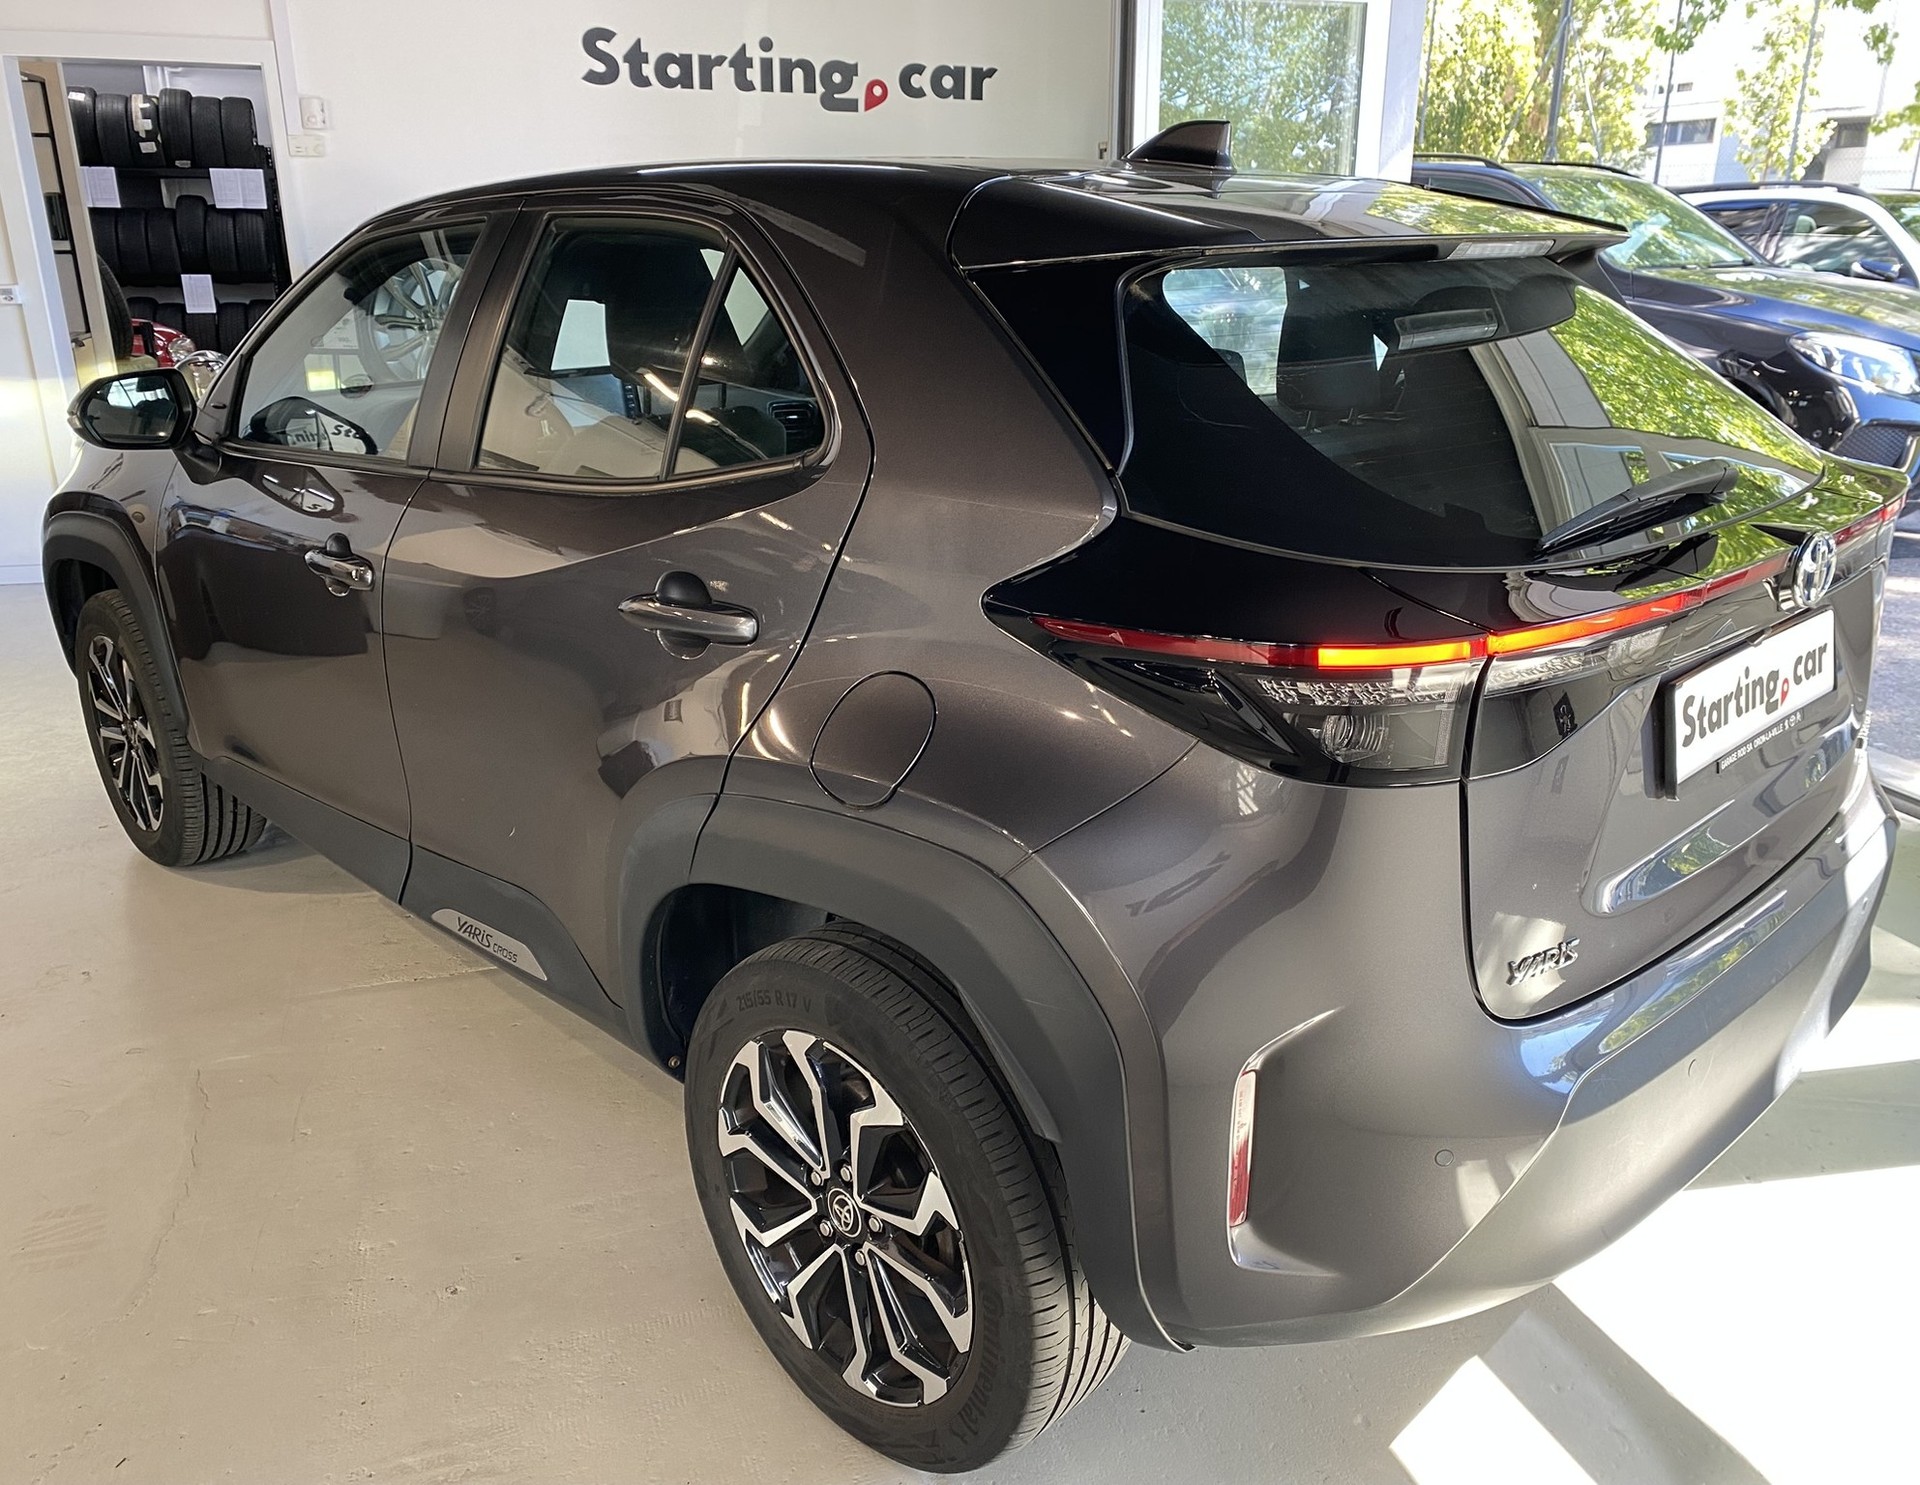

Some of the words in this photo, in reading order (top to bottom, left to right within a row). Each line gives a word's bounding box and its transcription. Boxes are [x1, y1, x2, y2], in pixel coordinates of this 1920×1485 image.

[581, 26, 859, 113] Starting
[899, 62, 998, 101] car
[1682, 666, 1780, 748] Starting
[1793, 642, 1828, 686] car
[492, 942, 518, 963] CROSS
